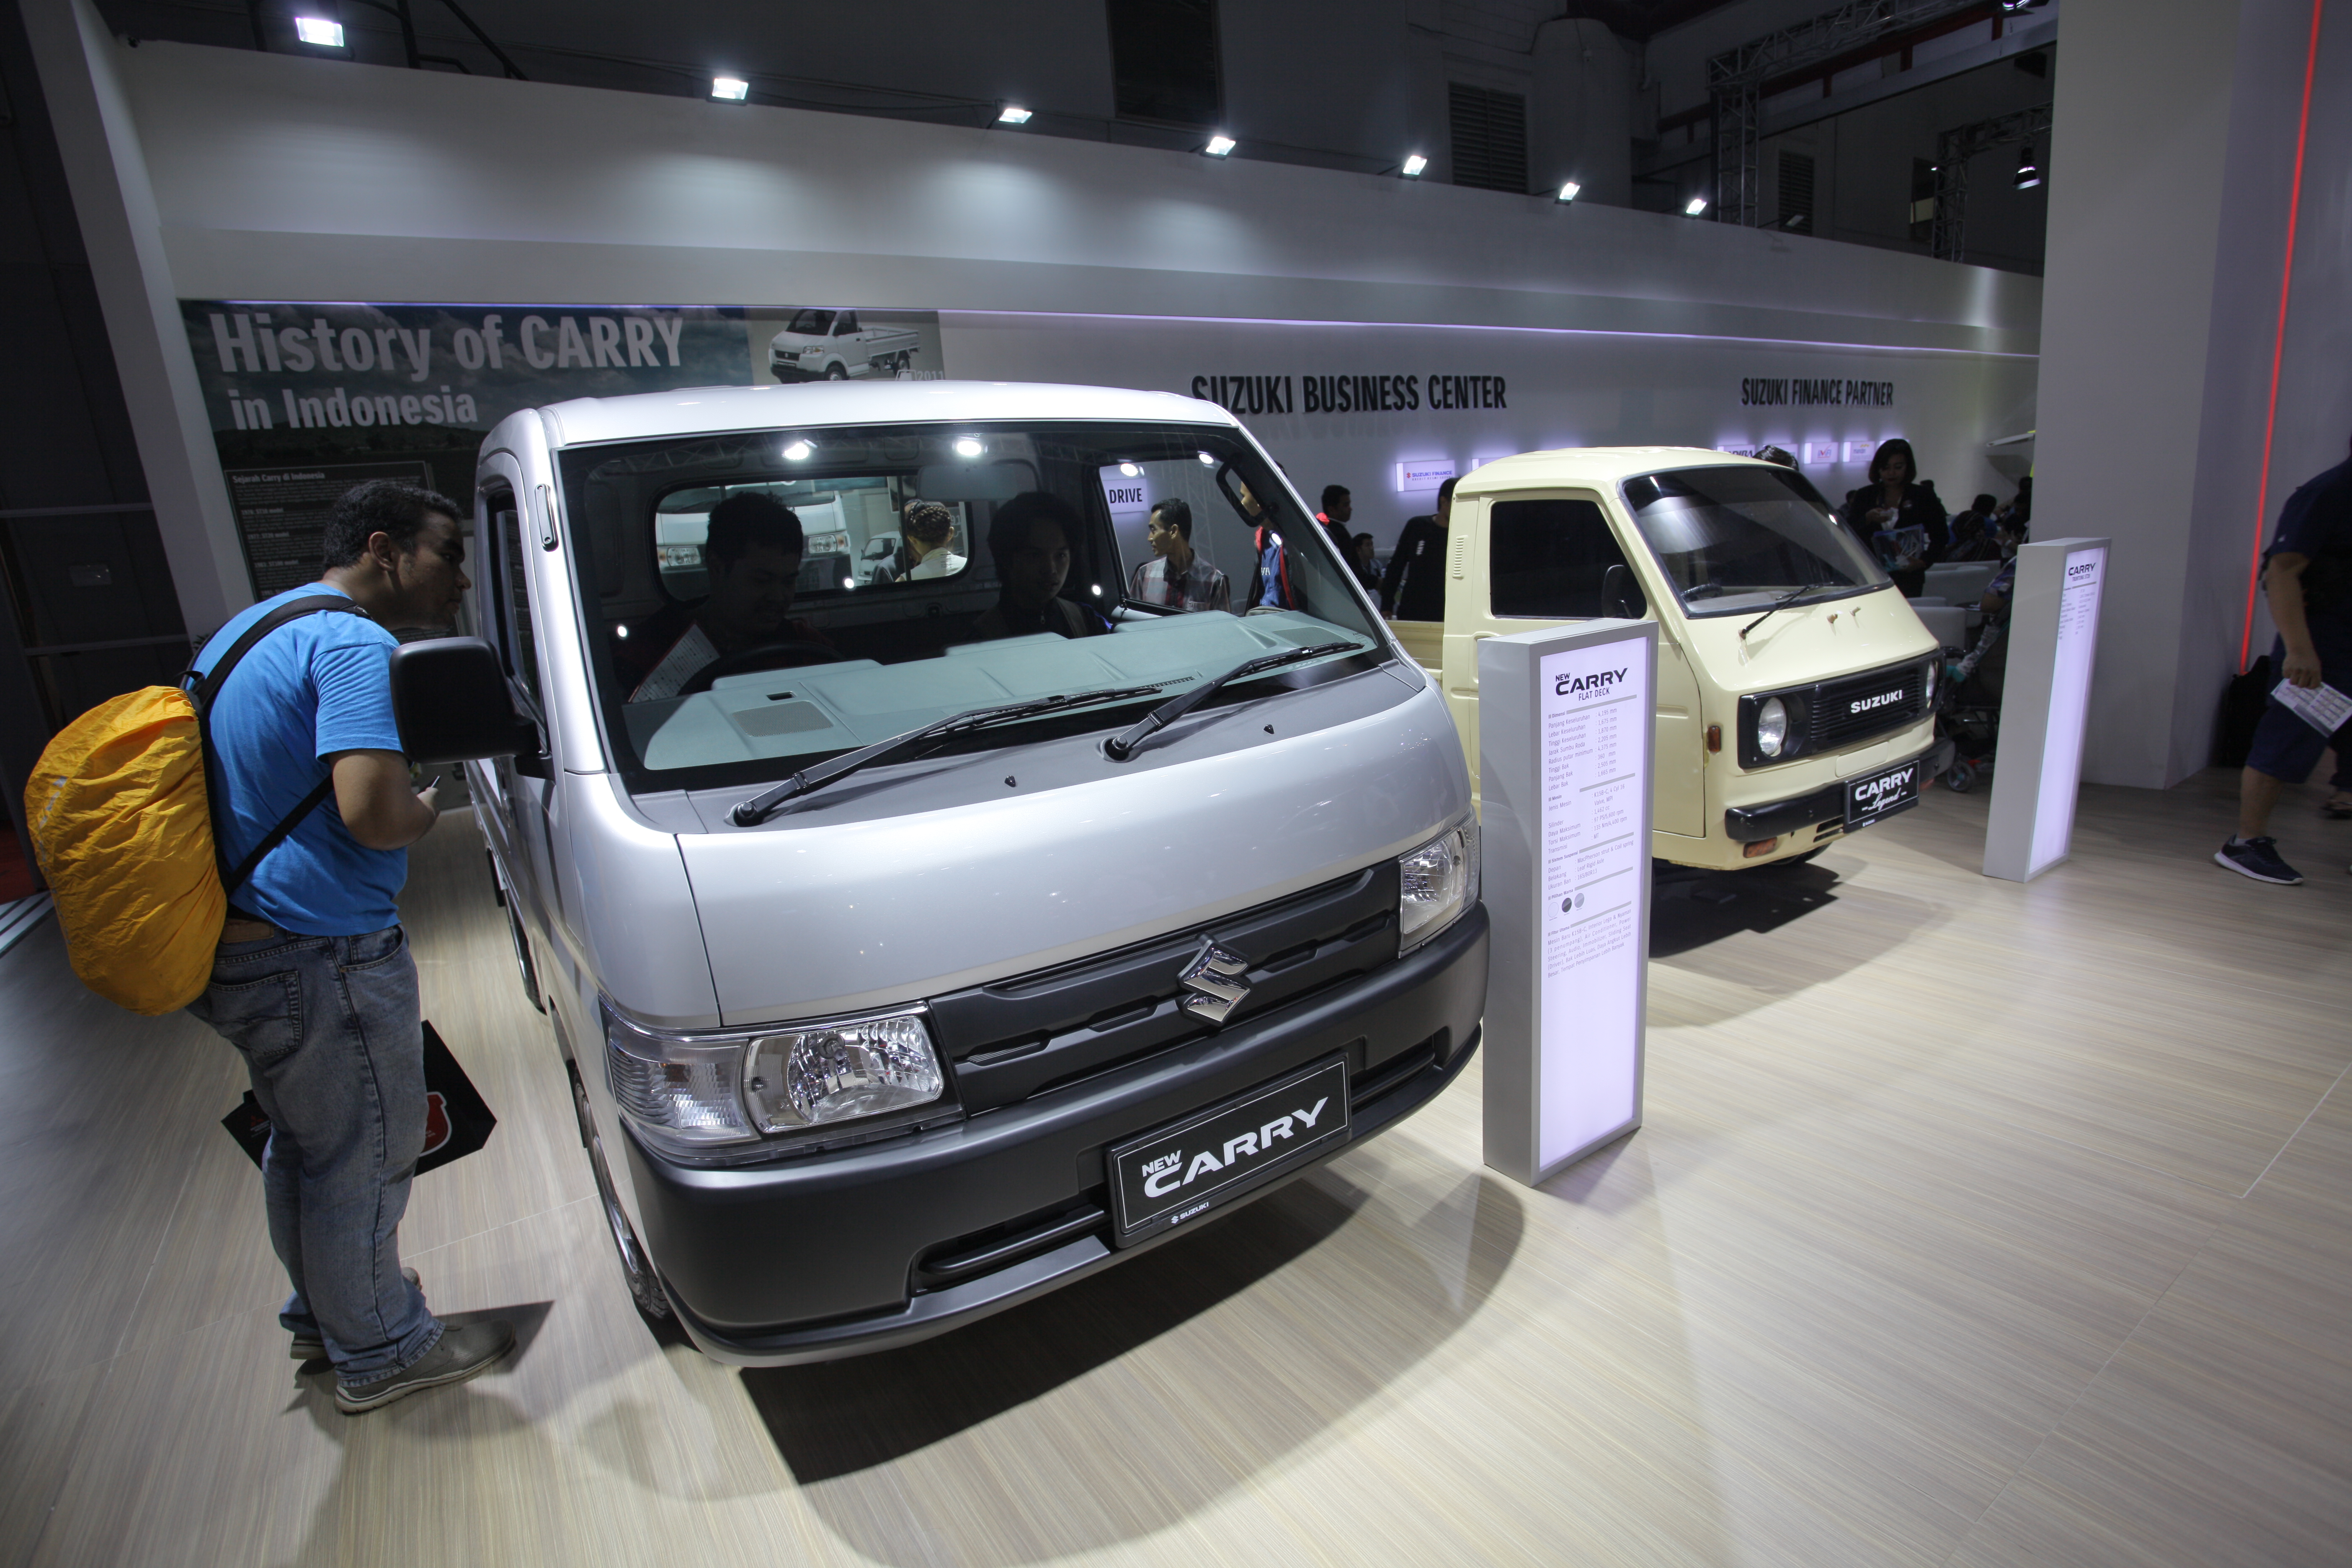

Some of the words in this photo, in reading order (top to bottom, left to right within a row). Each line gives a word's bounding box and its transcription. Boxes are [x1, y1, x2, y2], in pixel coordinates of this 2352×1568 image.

[209, 313, 430, 382] History
[454, 315, 503, 369] of
[520, 315, 683, 369] CARRY
[1191, 375, 1293, 414] SUZUKI
[1302, 375, 1419, 413] BUSINESS
[1428, 374, 1508, 410] CENTER
[1742, 378, 1788, 405] SUZUKI
[1792, 379, 1842, 405] FINANCE
[1845, 380, 1893, 405] PARTNER
[227, 389, 273, 430] in
[283, 386, 477, 429] Indonesia
[262, 474, 281, 482] Carry
[1109, 488, 1142, 503] DRIVE
[2068, 562, 2096, 576] CARRY
[1555, 673, 1571, 682] NEW
[1556, 668, 1628, 696] CARRY
[1578, 691, 1593, 701] FLAT
[1595, 687, 1610, 697] DECK
[1851, 690, 1902, 713] SUZUKI
[1566, 714, 1590, 725] Keseluruhan
[1561, 725, 1586, 735] Keseluruhan
[1562, 733, 1586, 743] Keseluruhan
[1575, 748, 1593, 758] minimum
[1549, 774, 1565, 782] Panjang
[1855, 768, 1914, 800] CARRY
[1549, 820, 1564, 829] Silinder
[1560, 823, 1581, 833] Maksimum
[1560, 831, 1581, 842] Maksimum
[1548, 843, 1568, 854] Transmisi
[1578, 851, 1600, 863] MacPherson
[1548, 872, 1567, 882] Belakang
[1548, 881, 1562, 890] Ukuran
[1578, 869, 1597, 880] 165/80R13
[1589, 921, 1602, 930] Interior
[1617, 909, 1631, 918] Nyaman
[1554, 936, 1583, 952] penumpang),
[1592, 922, 1617, 936] Conditioner,
[1619, 917, 1631, 925] Power
[1548, 951, 1567, 962] Steering,
[1568, 946, 1581, 954] Audio,
[1583, 935, 1607, 948] Immobilizer,
[1608, 928, 1621, 937] Sliding
[1548, 959, 1564, 970] (Driver),
[1574, 951, 1585, 959] Lebih
[1607, 936, 1620, 945] Angkut
[1621, 931, 1631, 940] Lebih
[1560, 962, 1575, 972] Tempat
[1576, 952, 1601, 966] Penyimpanan
[1602, 947, 1611, 955] Lebih
[1612, 942, 1625, 951] Banyak
[1144, 1097, 1328, 1197] CARRY
[1142, 1150, 1181, 1177] NEW
[1180, 1202, 1209, 1220] SUZUKI
